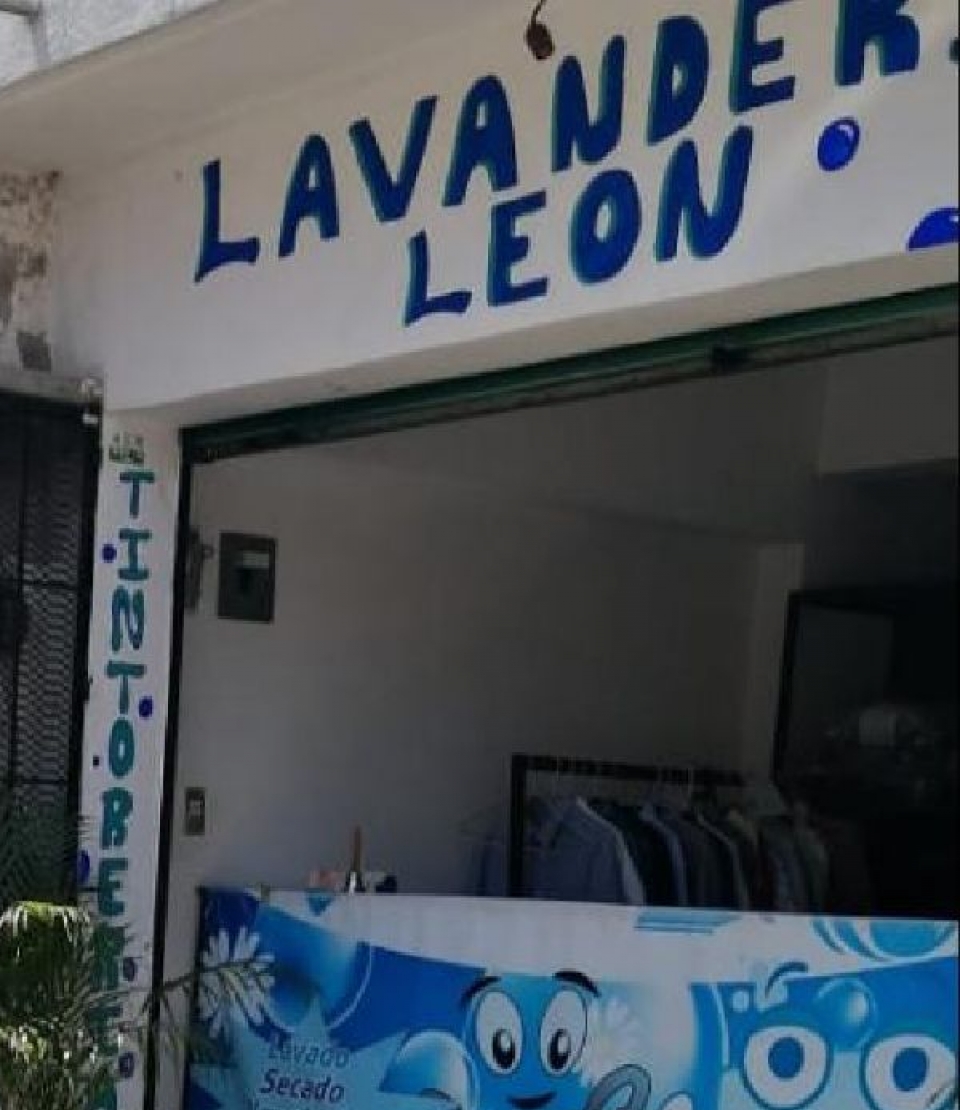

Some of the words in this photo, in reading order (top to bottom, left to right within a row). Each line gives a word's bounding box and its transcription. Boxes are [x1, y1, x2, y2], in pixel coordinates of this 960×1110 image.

[194, 0, 958, 282] LAVANDER
[404, 125, 752, 326] LEON
[259, 1067, 346, 1104] Secado
